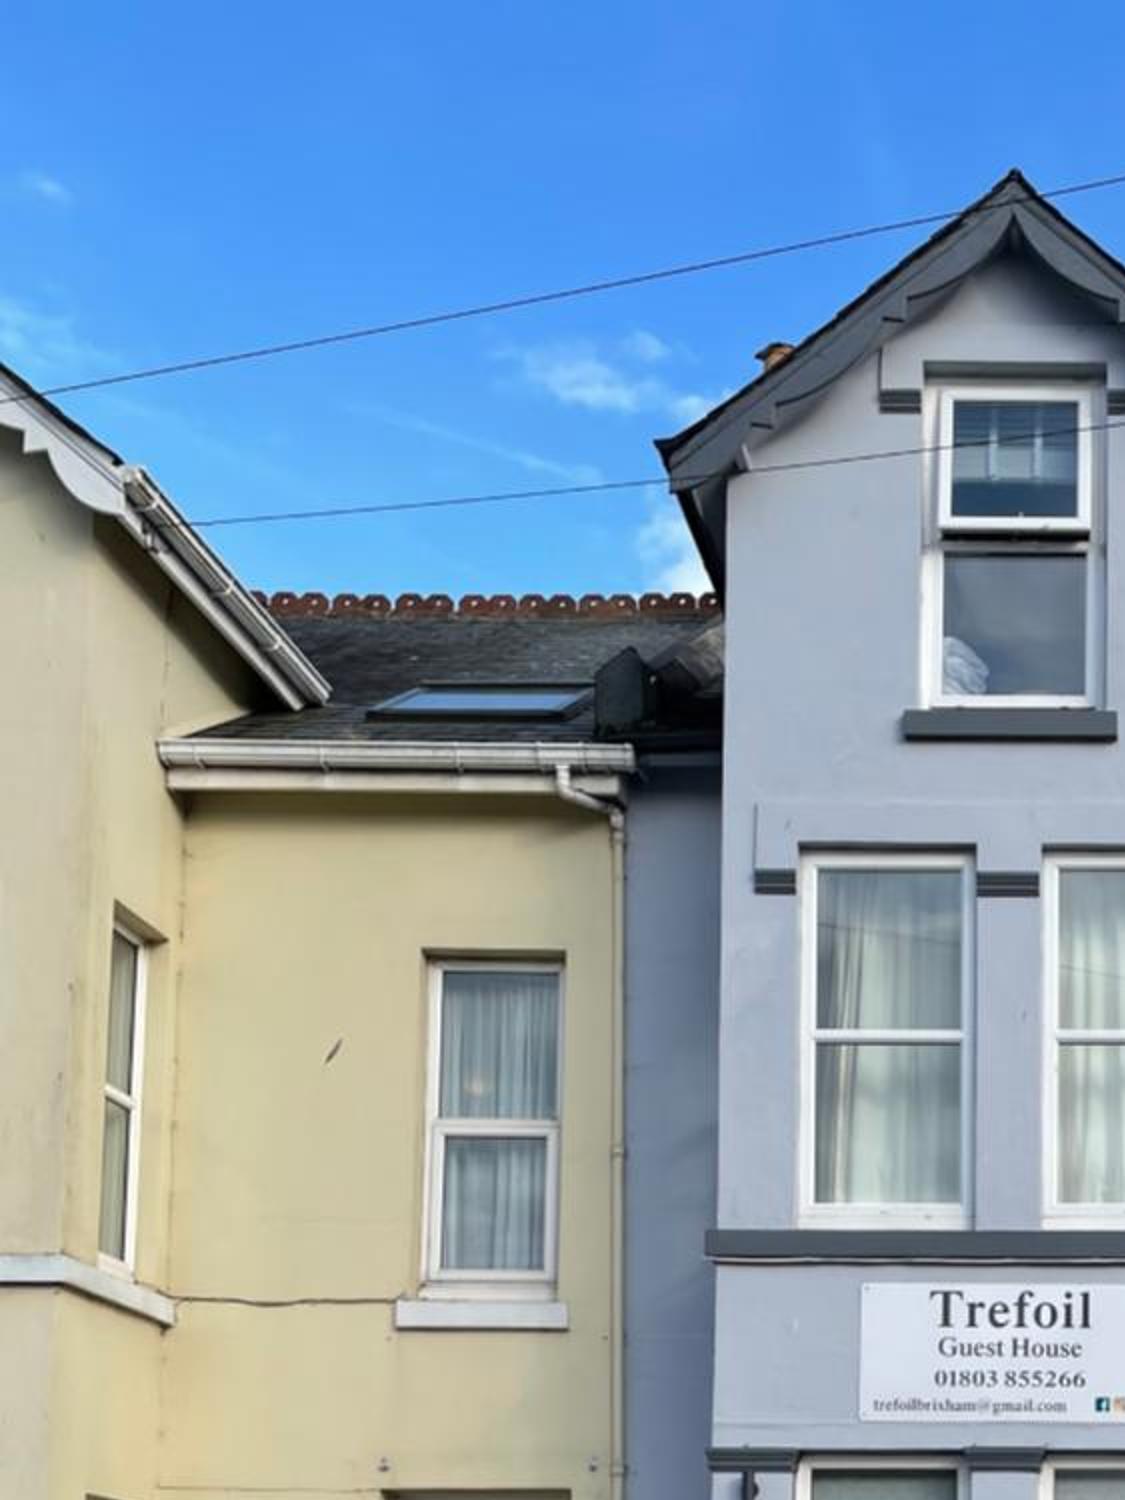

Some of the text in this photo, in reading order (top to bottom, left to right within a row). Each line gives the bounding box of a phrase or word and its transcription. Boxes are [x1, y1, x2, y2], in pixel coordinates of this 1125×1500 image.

[930, 1290, 1091, 1329] Trefoil
[938, 1336, 1083, 1359] Guest House
[934, 1369, 1087, 1389] 01803 855266
